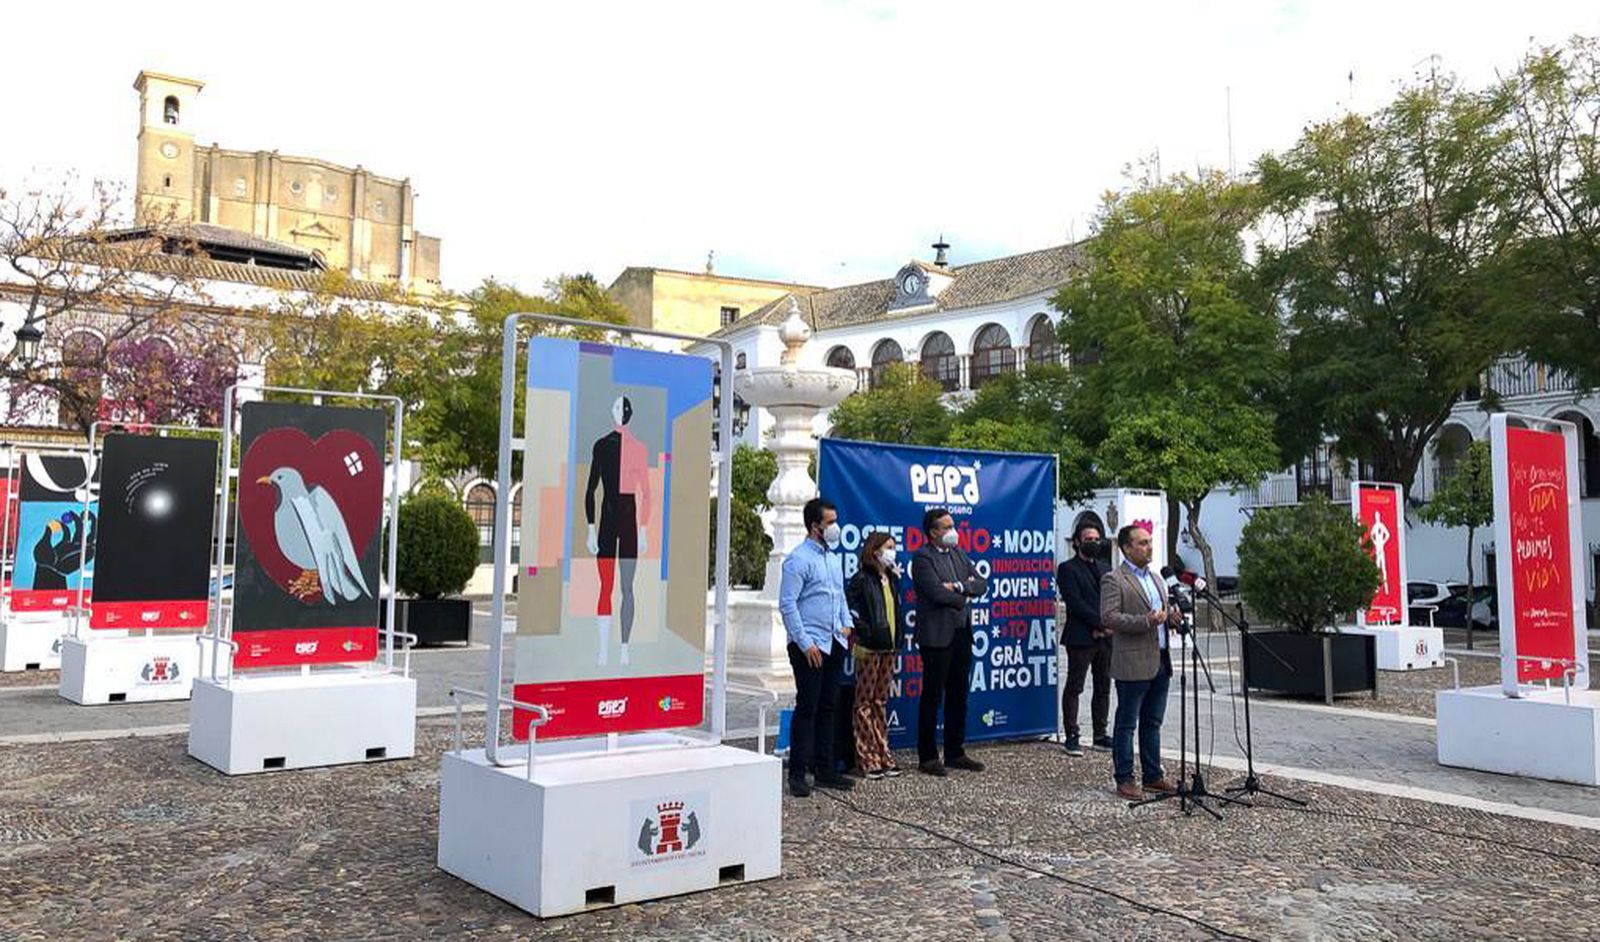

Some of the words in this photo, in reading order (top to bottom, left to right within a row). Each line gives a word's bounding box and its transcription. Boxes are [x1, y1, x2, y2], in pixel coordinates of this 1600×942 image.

[992, 577, 1039, 598] JOVEN
[991, 639, 1024, 667] GRÁ
[990, 667, 1031, 690] FICO
